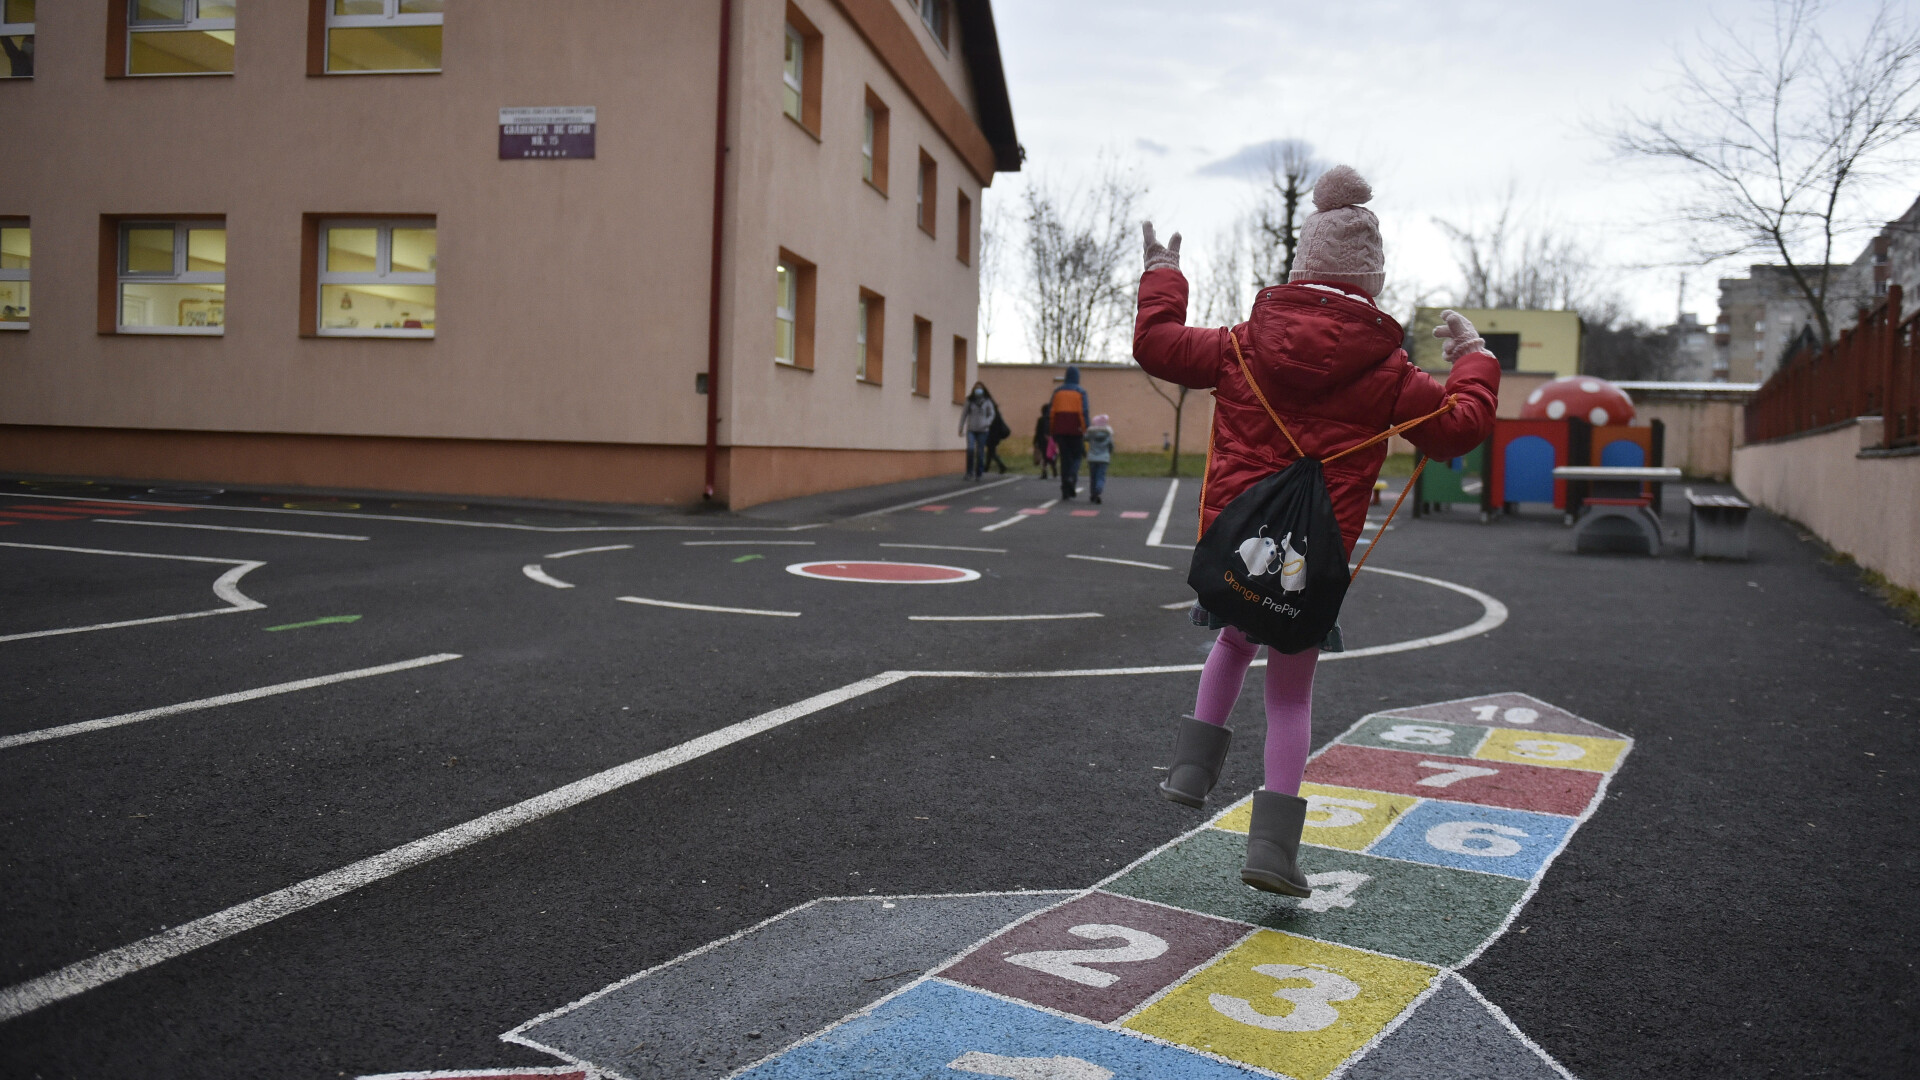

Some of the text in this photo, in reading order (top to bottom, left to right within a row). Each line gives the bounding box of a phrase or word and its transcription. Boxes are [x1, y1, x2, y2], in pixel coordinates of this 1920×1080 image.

[1224, 571, 1301, 618] Orange PrePay
[1471, 704, 1538, 724] 10
[1380, 725, 1455, 745] 8
[1507, 739, 1586, 761] 9
[1416, 760, 1500, 788] 7
[1300, 795, 1375, 827] 5
[1426, 821, 1529, 857] 6
[1004, 924, 1170, 988] 2
[1208, 963, 1361, 1032] 3
